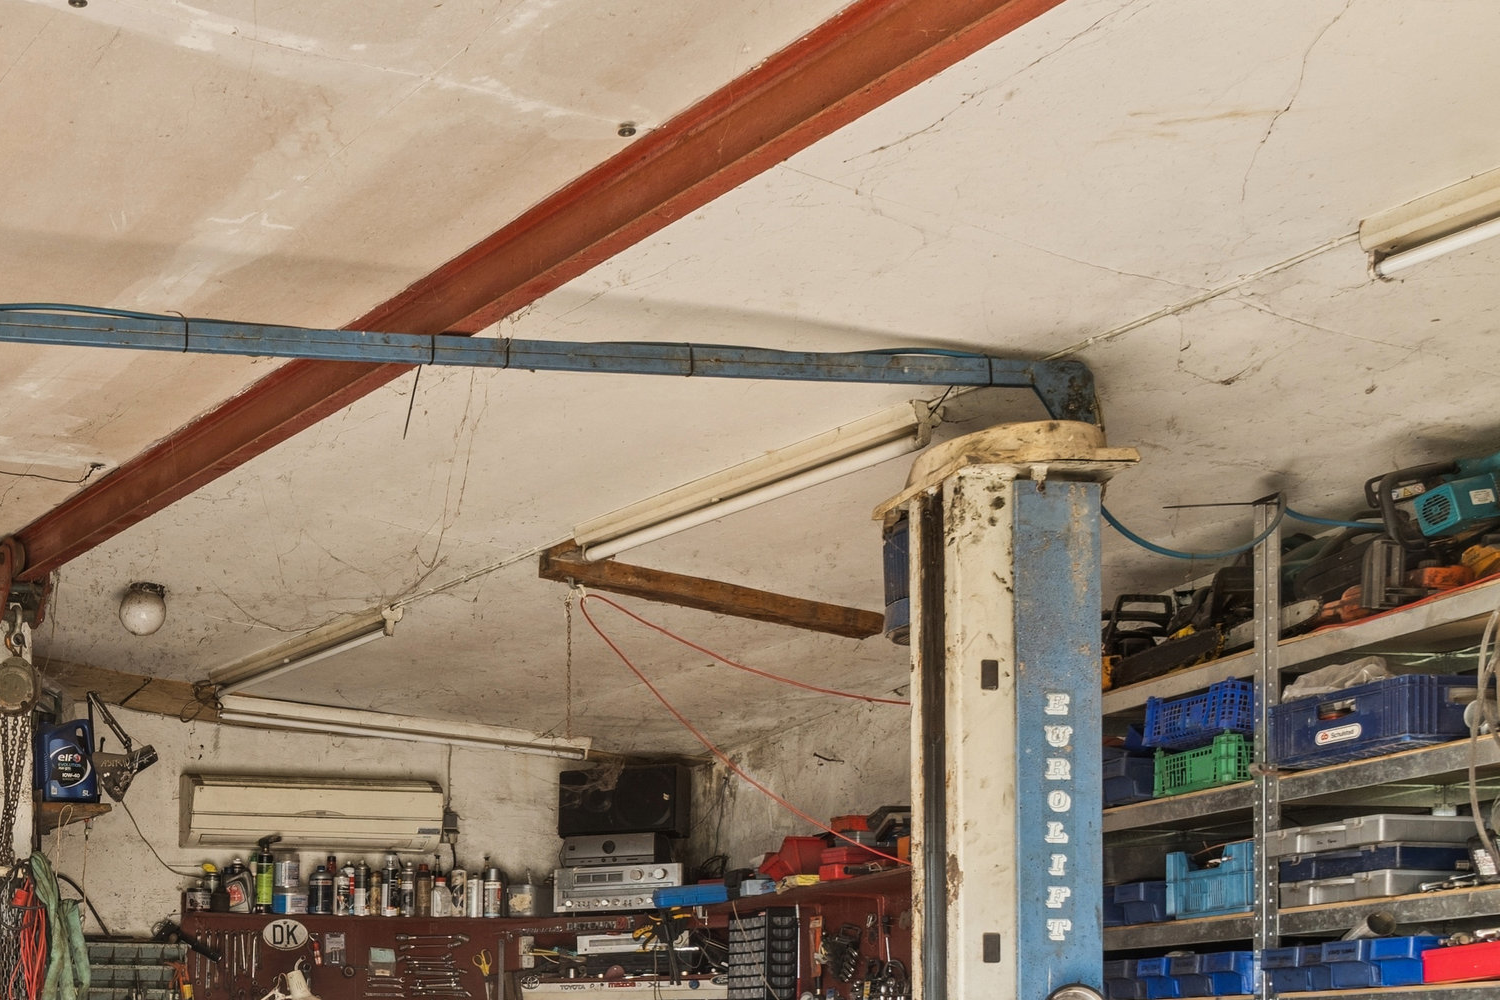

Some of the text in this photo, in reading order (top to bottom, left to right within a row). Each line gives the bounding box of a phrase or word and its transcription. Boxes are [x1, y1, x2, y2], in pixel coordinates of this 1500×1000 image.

[57, 754, 73, 762] elf
[1044, 693, 1073, 941] EUROLIFT
[273, 925, 298, 945] DK
